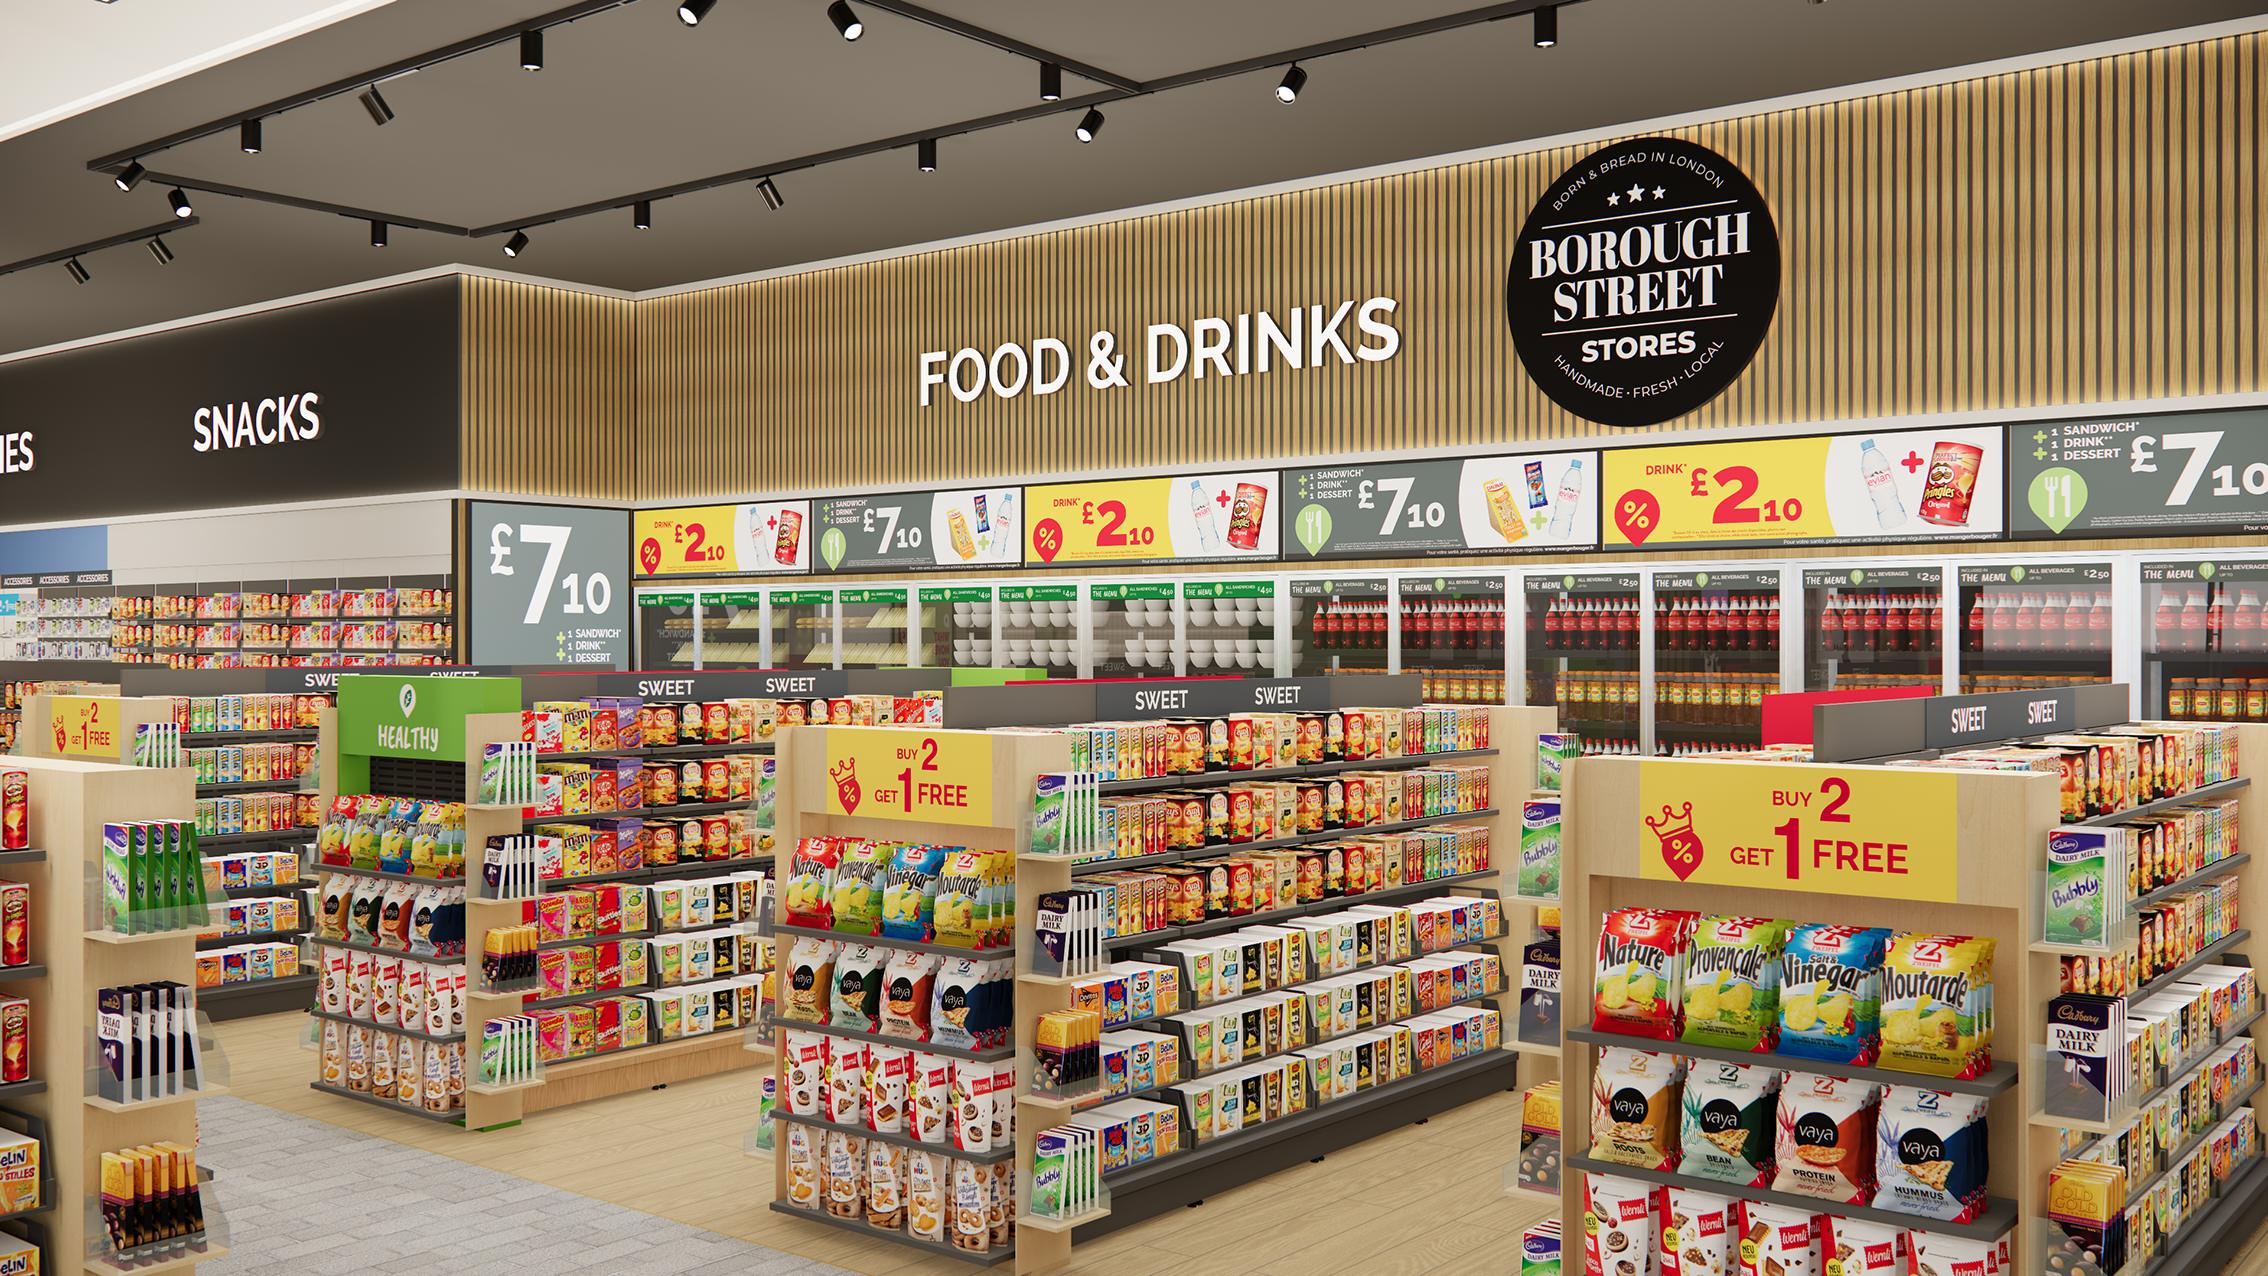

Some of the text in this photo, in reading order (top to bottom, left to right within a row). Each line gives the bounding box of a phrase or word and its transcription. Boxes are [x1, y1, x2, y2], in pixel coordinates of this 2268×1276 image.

[1553, 152, 1725, 211] BORN & BREAD IN LONDON
[1529, 211, 1751, 280] BOROUGH
[1553, 264, 1724, 323] STREET
[920, 296, 1400, 407] FOOD & DRINKS
[1581, 330, 1696, 363] STORES
[1554, 339, 1725, 398] HANDMADE FRESH LOCAL
[193, 391, 320, 453] SNACKS
[2051, 428, 2058, 436] 1
[2051, 440, 2058, 448] 1
[2051, 448, 2121, 461] 1 DESSERT
[1309, 472, 1314, 480] 1
[1867, 472, 1891, 487] evian
[1317, 489, 1353, 499] DESSERT
[1559, 491, 1577, 500] evian
[1923, 484, 1955, 503] Pringles
[1928, 501, 1950, 509] Original
[836, 516, 860, 524] DESSERT
[4, 576, 33, 586] ACCESSORIES
[39, 575, 70, 584] ACCESSORIES
[76, 573, 109, 583] ACCESSORIES
[1805, 576, 1847, 585] THE MENU
[1961, 572, 2007, 582] THE MENU
[2144, 570, 2194, 579] THE MENU
[1292, 586, 1321, 594] THE MENU
[1400, 583, 1432, 592] THE MENU
[1526, 580, 1561, 590] THE MENU
[1655, 578, 1693, 588] THE MENU
[1185, 587, 1212, 596] THE MENU
[568, 630, 572, 638] 1
[568, 642, 572, 650] 1
[575, 653, 611, 663] DESSERT
[638, 679, 695, 696] SWEET
[765, 677, 816, 693] SWEET
[1135, 689, 1189, 711] SWEET
[1255, 686, 1301, 705] SWEET
[81, 702, 98, 723] BUY 2
[1951, 706, 1987, 734] SWEET
[2027, 700, 2058, 725] SWEET
[71, 725, 110, 751] GET 1 FREE
[378, 724, 439, 752] HEALTHY
[897, 738, 938, 771] BUY 2
[874, 768, 968, 813] GET 1 FREE
[1772, 777, 1851, 823] BUY 2
[1524, 839, 1558, 867] Bubbly
[1730, 817, 1909, 880] GET 1 FREE
[792, 854, 826, 880] Nature
[936, 870, 982, 900] Moutarde
[2051, 875, 2099, 909] Bubbly
[1603, 932, 1666, 972] Nature
[1688, 938, 1762, 981] Provençale
[1528, 969, 1561, 980] DAIRY
[1781, 953, 1868, 992] Vinegar
[1530, 977, 1558, 988] MILK
[1880, 966, 1968, 1008] Moutarde
[2057, 1005, 2100, 1024] Cadbury
[2056, 1028, 2100, 1043] DAIRY
[2059, 1039, 2096, 1053] MILK
[1613, 1099, 1644, 1117] vaya
[1704, 1110, 1738, 1129] vaya
[1799, 1124, 1834, 1144] vaya
[1613, 1143, 1646, 1155] ROOTS
[1902, 1140, 1940, 1160] vaya
[1706, 1155, 1732, 1165] BEAN
[1793, 1168, 1836, 1182] PROTEIN
[1894, 1186, 1944, 1200] HUMMUS
[1622, 1204, 1645, 1217] Wernli
[1700, 1219, 1722, 1232] Wernli
[1665, 1233, 1677, 1241] NEU
[1781, 1230, 1809, 1245] Wernli
